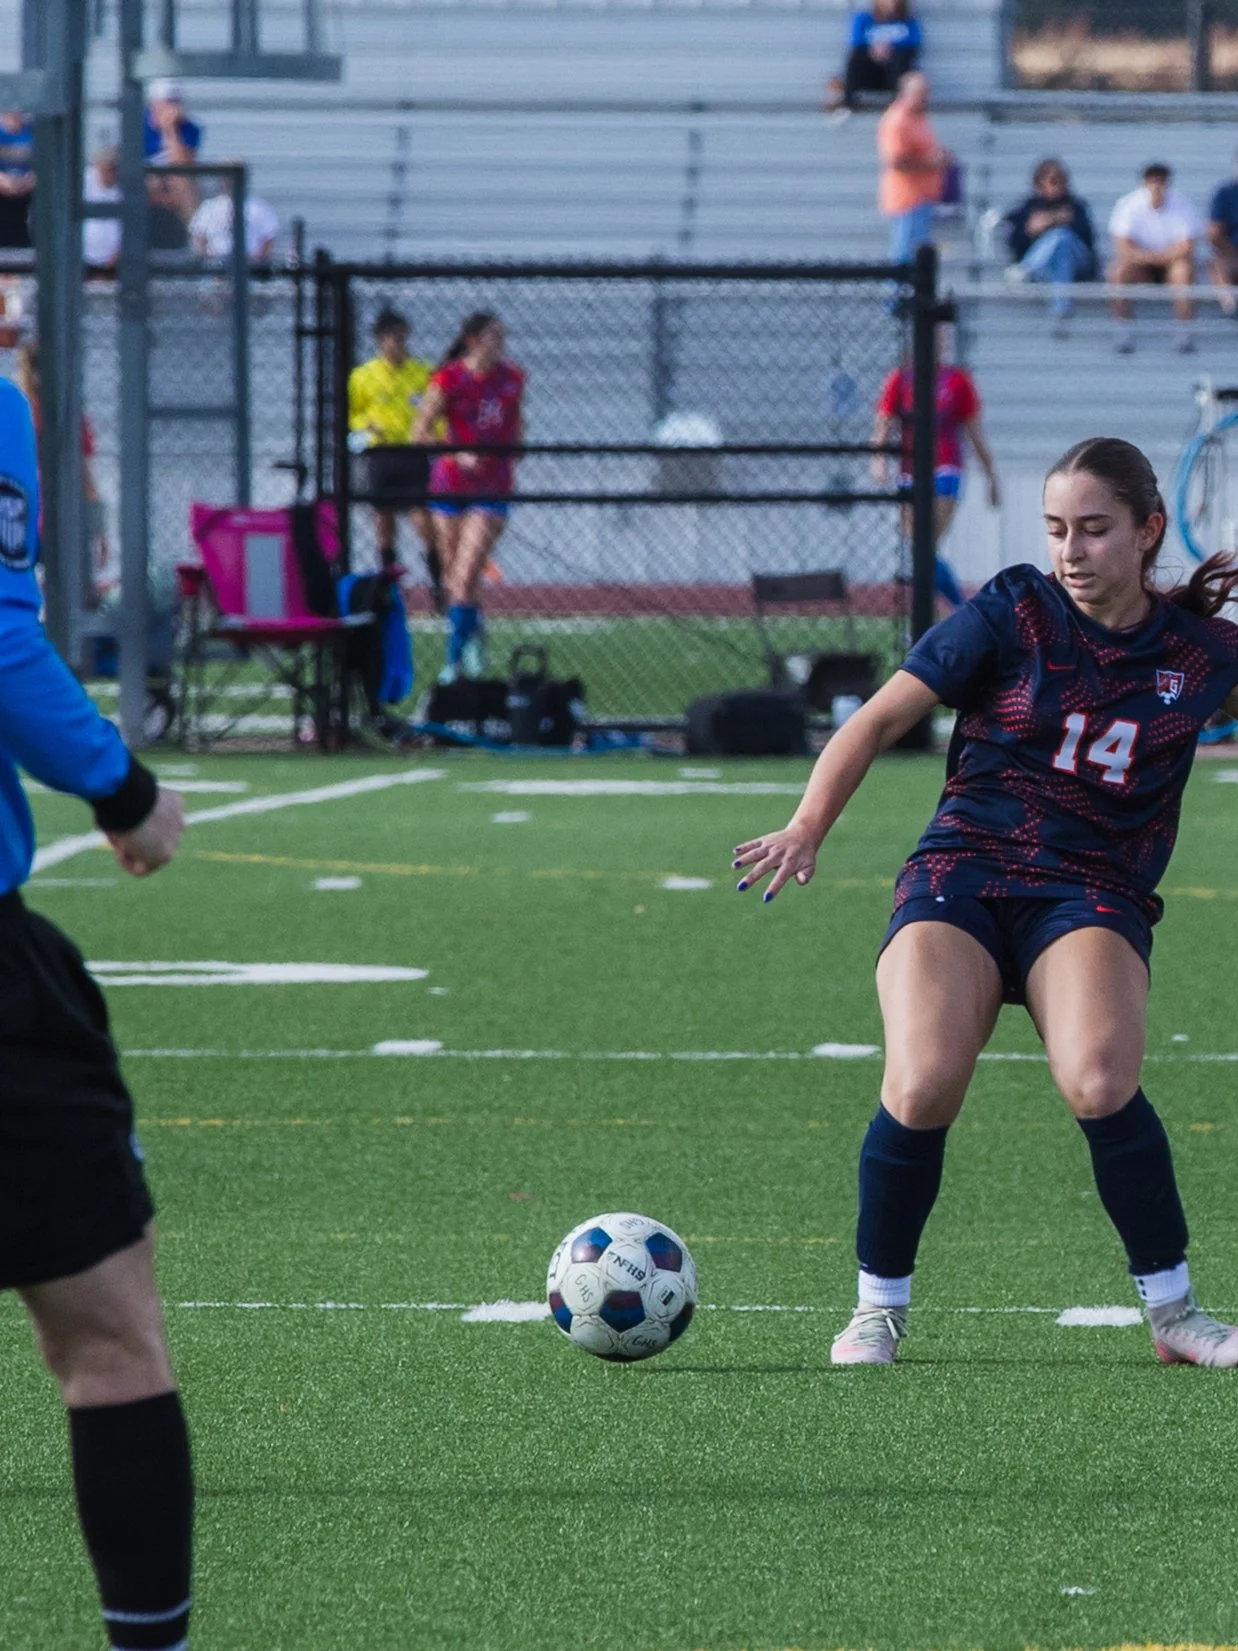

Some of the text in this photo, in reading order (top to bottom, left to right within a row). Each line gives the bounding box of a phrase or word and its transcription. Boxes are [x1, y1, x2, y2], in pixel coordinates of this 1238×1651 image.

[1053, 711, 1140, 785] 14
[574, 1273, 595, 1304] GHS
[631, 1335, 658, 1350] GHS
